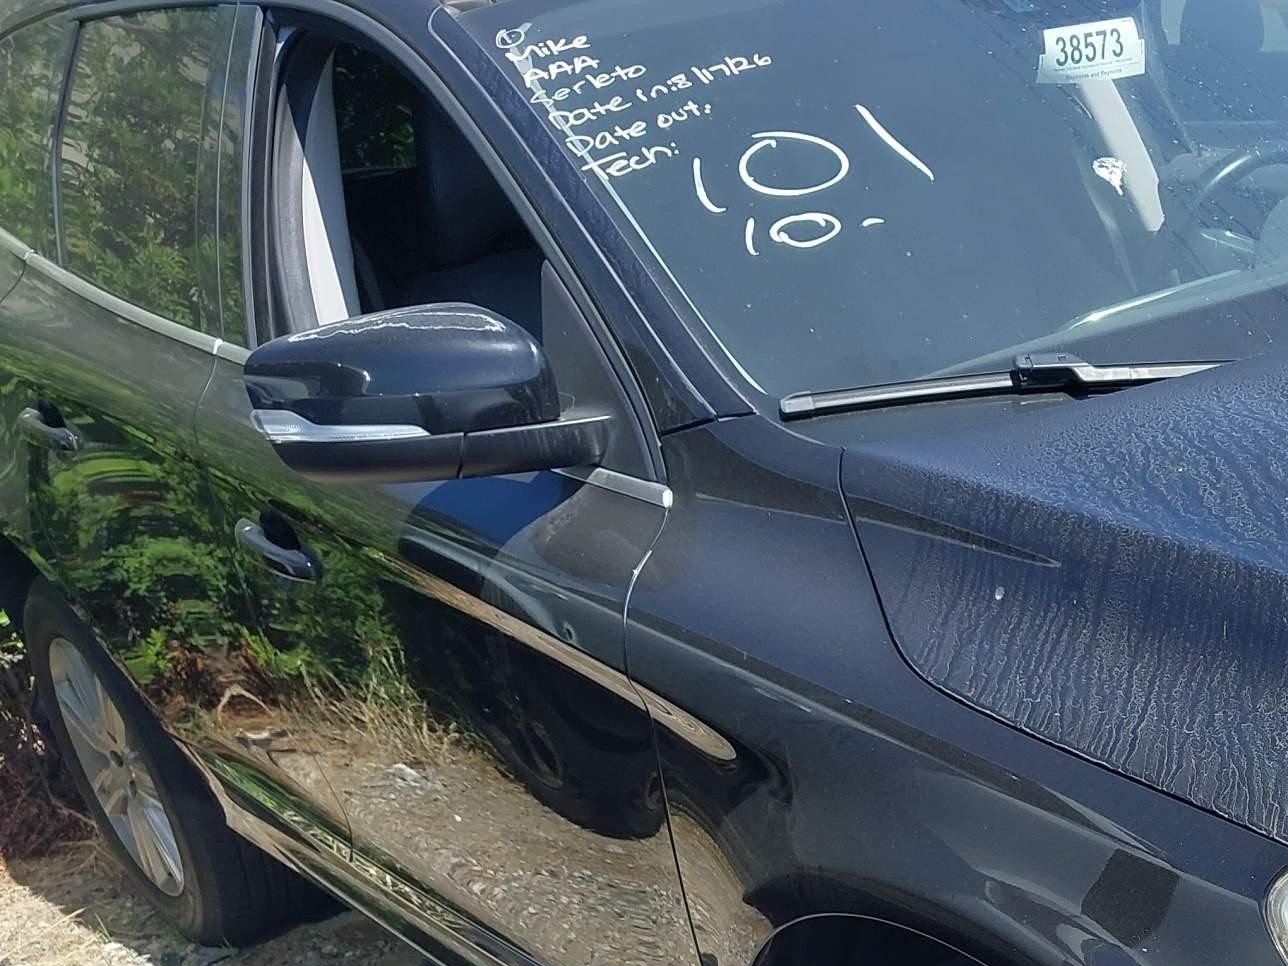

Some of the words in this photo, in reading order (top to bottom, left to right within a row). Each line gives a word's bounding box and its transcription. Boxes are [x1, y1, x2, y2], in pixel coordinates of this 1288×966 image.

[1055, 28, 1124, 67] 38573
[523, 55, 600, 88] AAA
[548, 96, 632, 130] Date
[565, 120, 647, 156] Date
[657, 101, 712, 129] out:
[581, 142, 679, 180] Tech:
